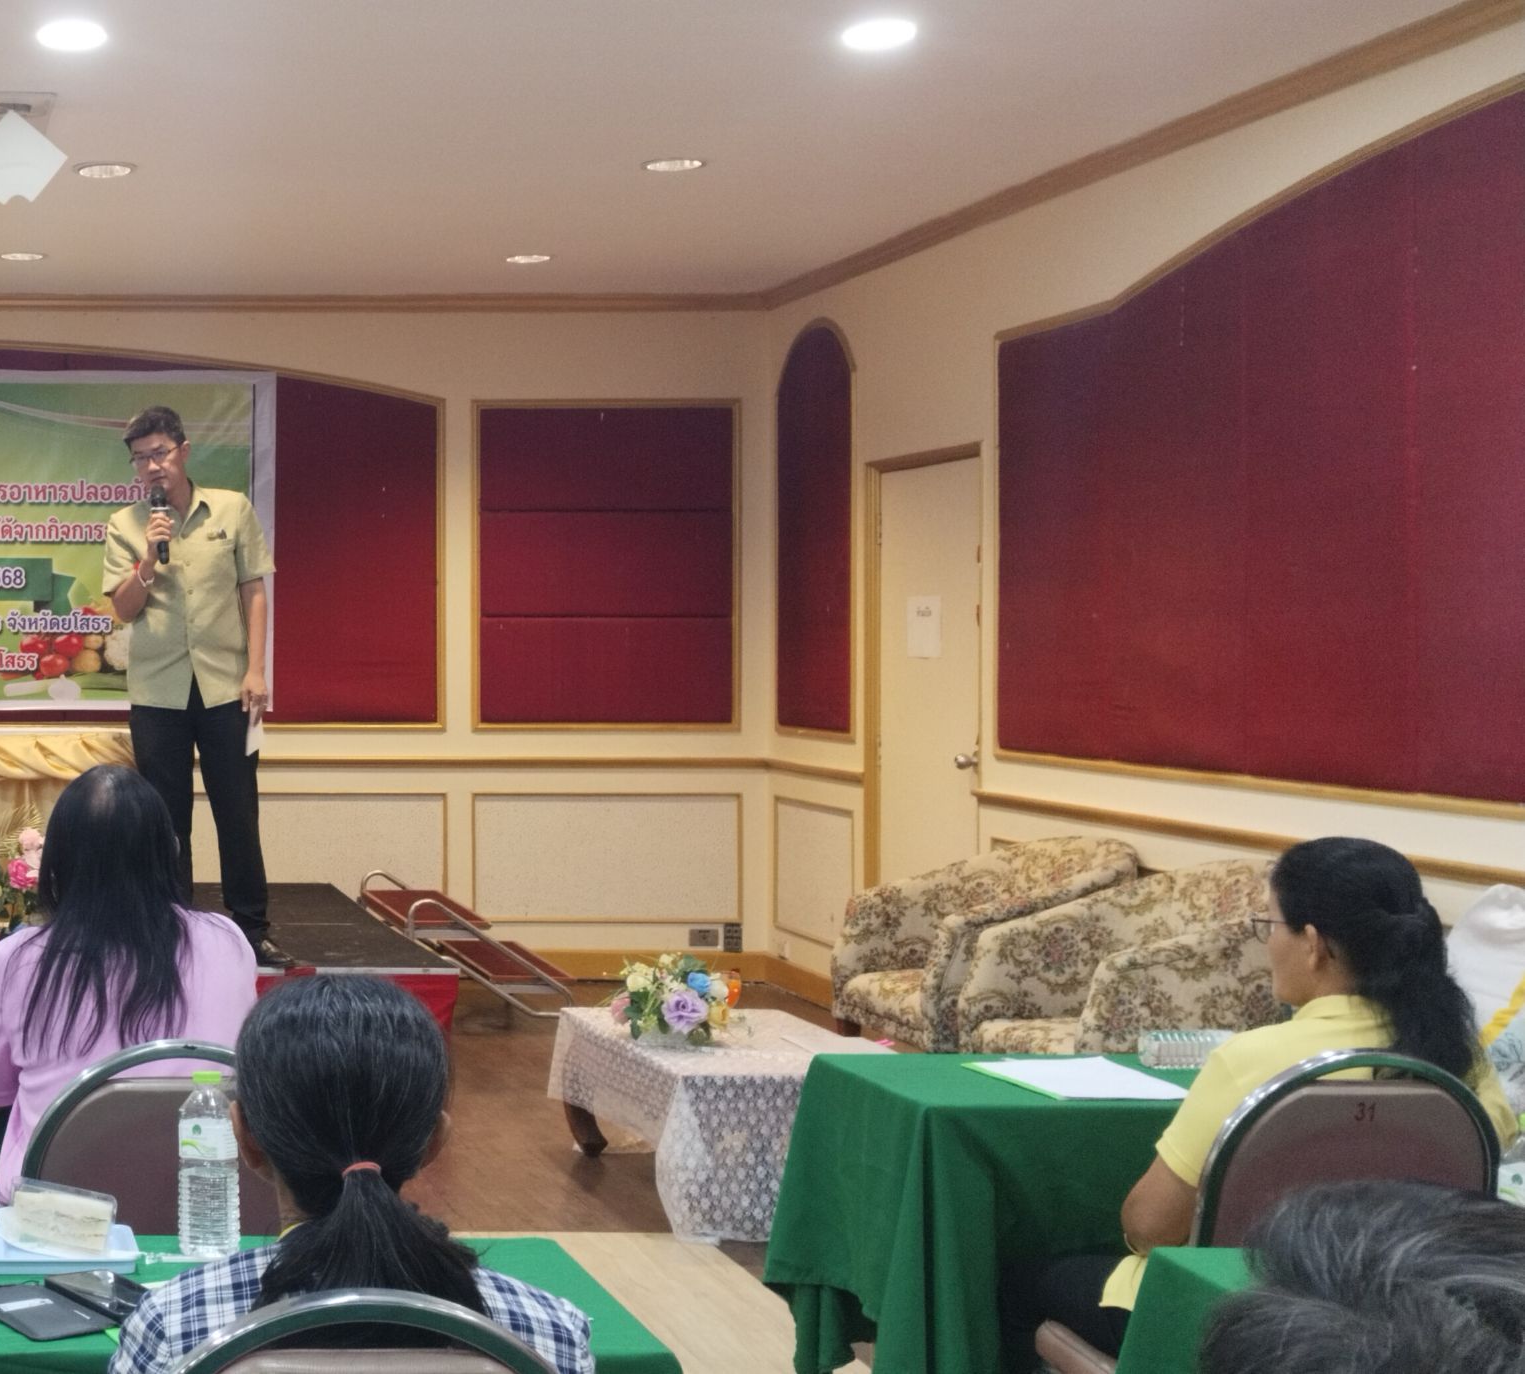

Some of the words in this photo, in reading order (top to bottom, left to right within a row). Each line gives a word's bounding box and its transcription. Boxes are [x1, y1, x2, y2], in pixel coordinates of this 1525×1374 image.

[8, 611, 112, 632] จังหวัดยโสธร
[1354, 1101, 1377, 1122] 31
